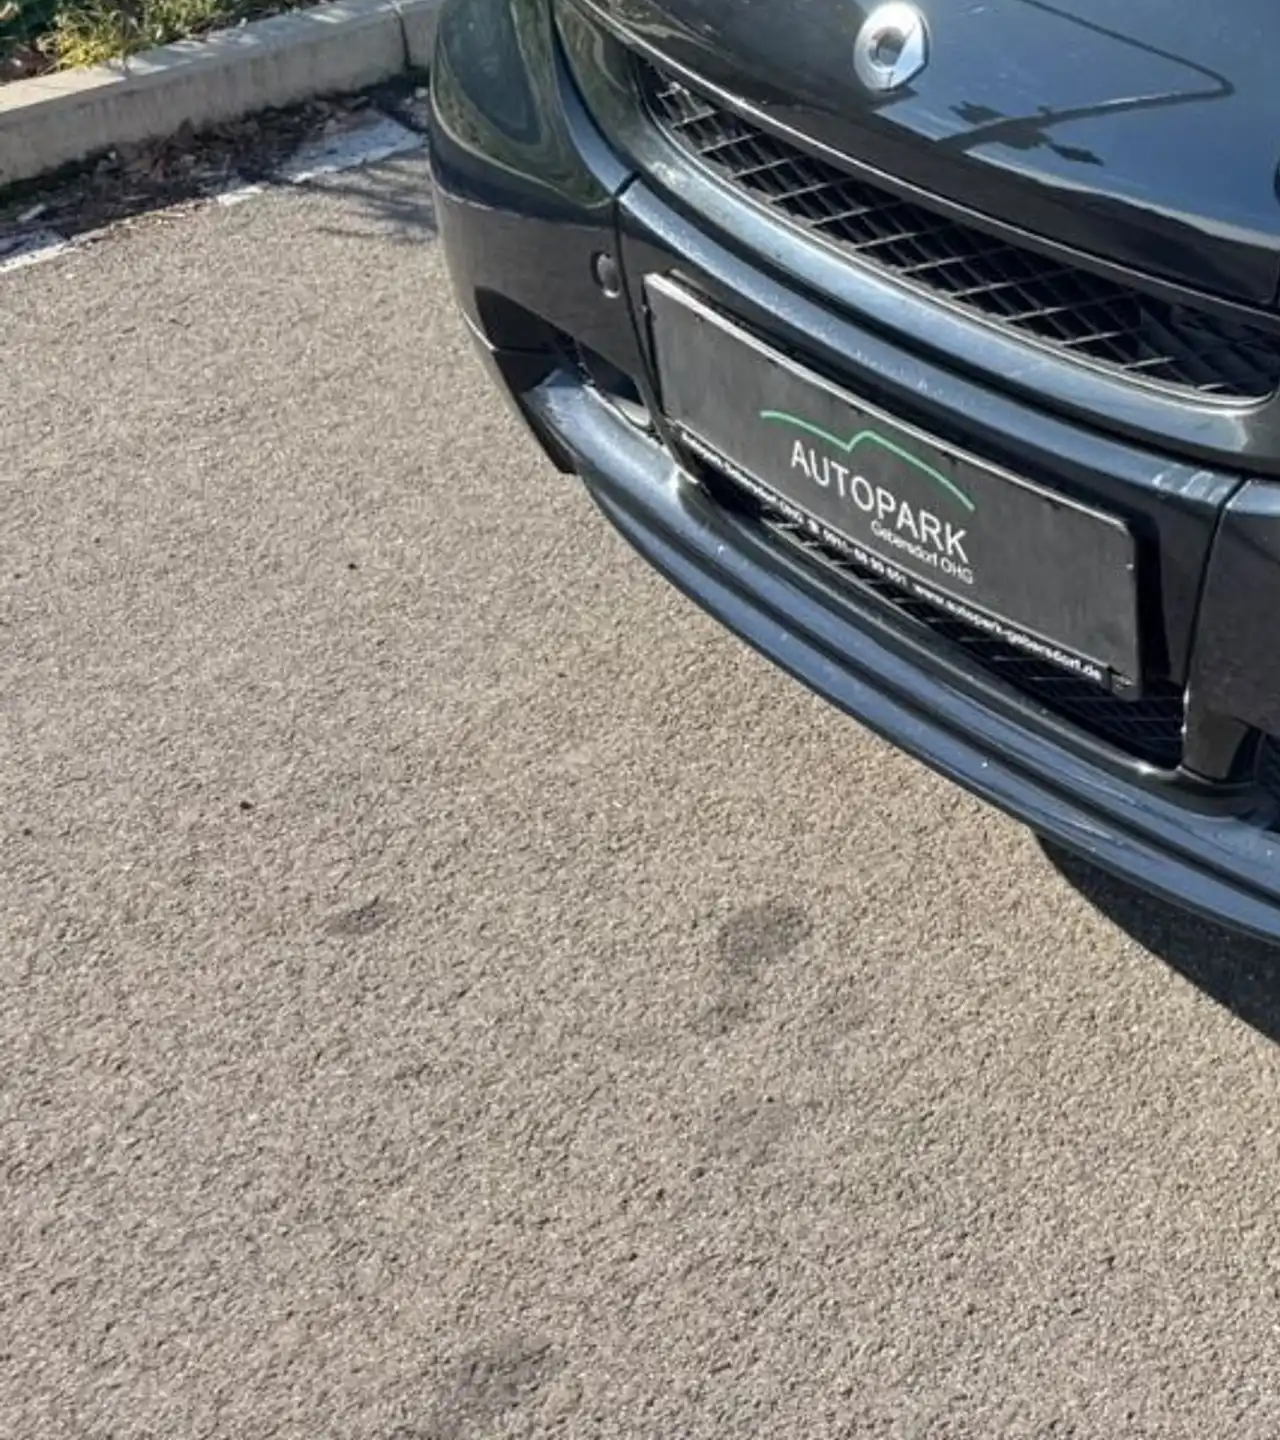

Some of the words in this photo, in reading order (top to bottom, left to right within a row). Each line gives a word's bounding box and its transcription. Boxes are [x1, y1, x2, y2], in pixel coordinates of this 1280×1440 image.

[790, 439, 970, 565] AUTOPARK
[870, 519, 938, 568] Gebersdorf
[940, 556, 974, 585] OHG
